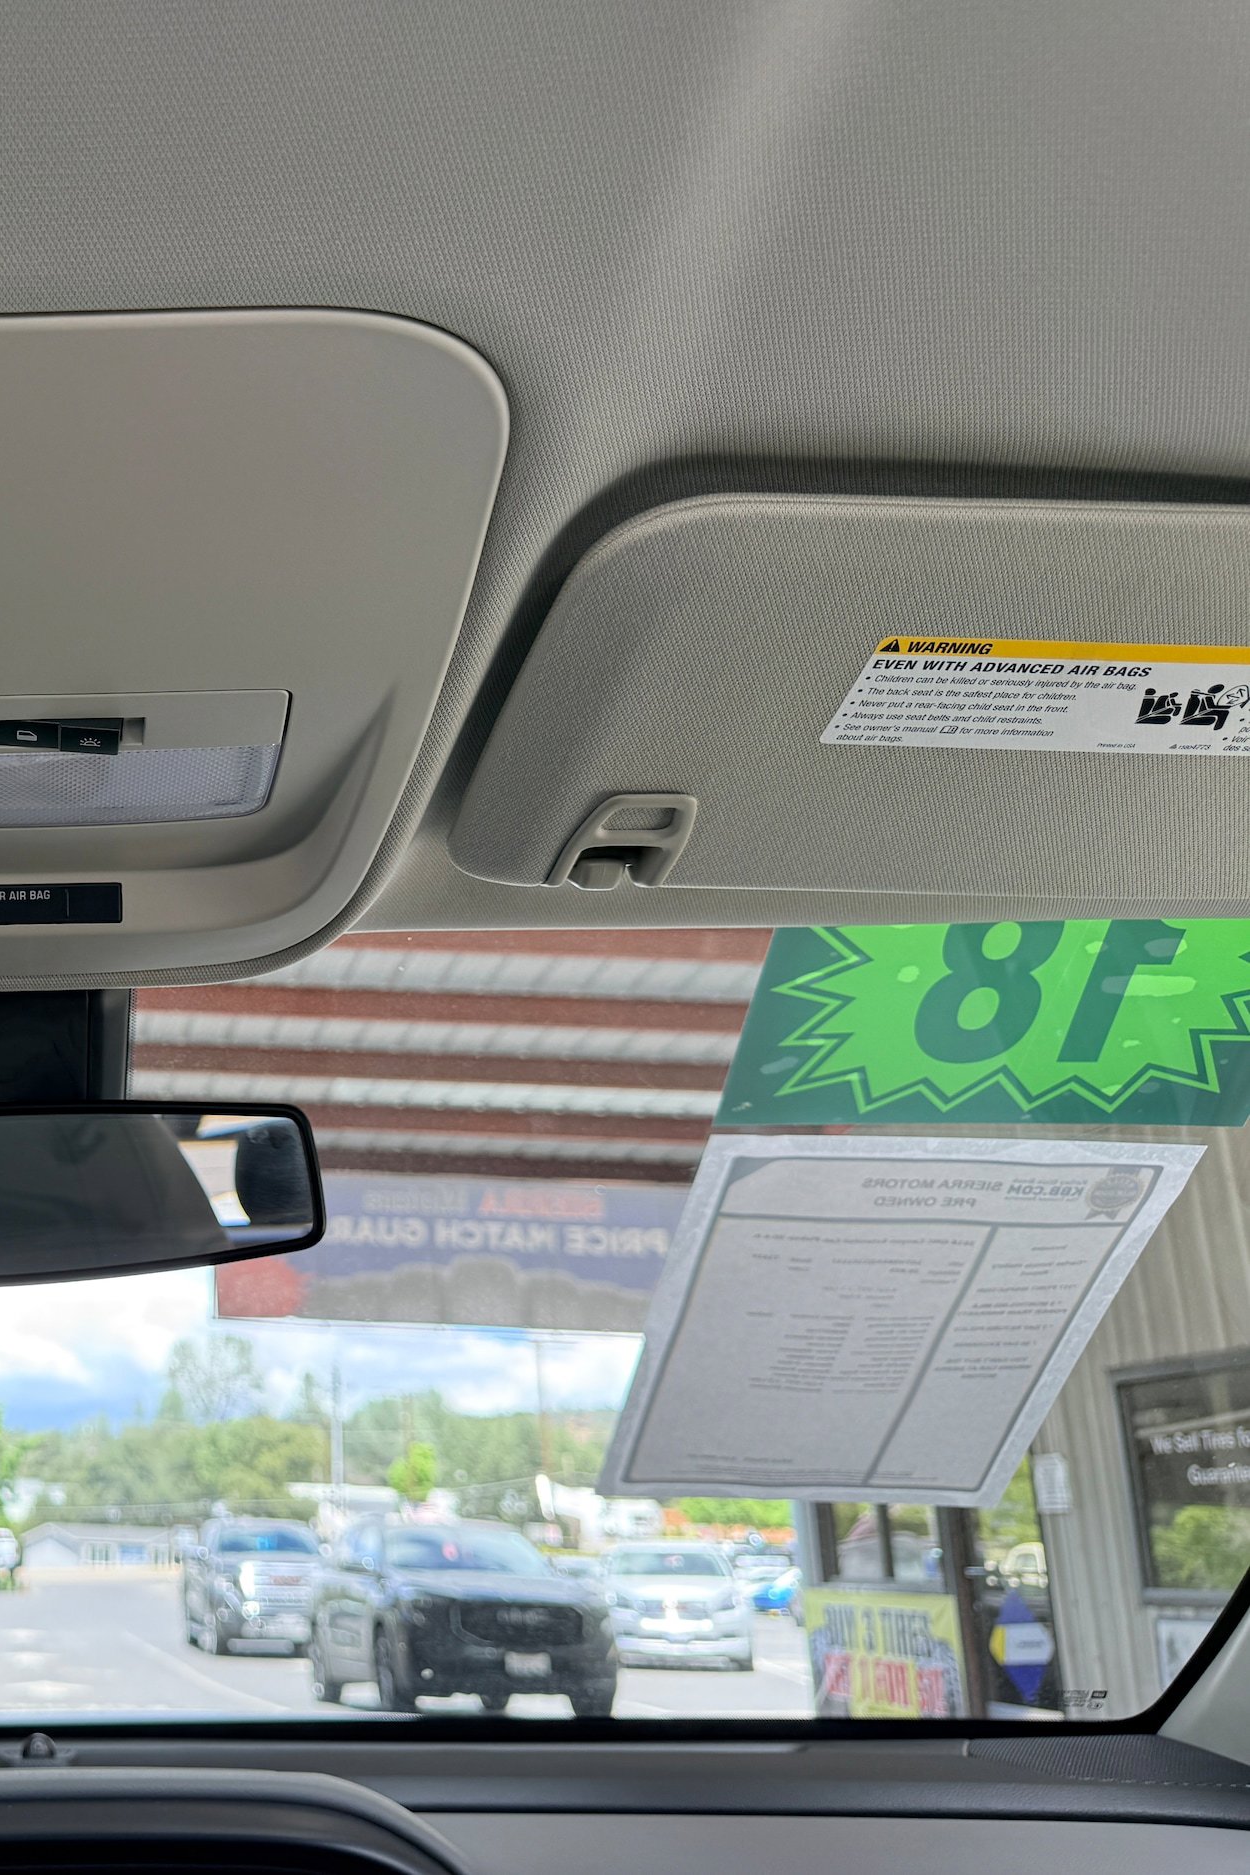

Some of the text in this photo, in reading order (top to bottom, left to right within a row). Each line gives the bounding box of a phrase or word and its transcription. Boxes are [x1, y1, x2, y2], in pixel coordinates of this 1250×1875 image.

[907, 642, 993, 654] WARNING
[873, 660, 1152, 677] EVEN WITH ADVANCED AIR BAGS
[875, 675, 914, 683] Children
[936, 676, 948, 684] be
[950, 677, 976, 685] killed
[991, 679, 1033, 688] seriously
[1035, 680, 1069, 689] injured
[1070, 680, 1082, 689] by
[1084, 681, 1100, 689] the
[1117, 683, 1137, 691] bag.
[962, 691, 992, 699] safest
[1037, 692, 1077, 701] children.
[888, 701, 905, 709] put
[914, 702, 965, 711] rear-facing
[850, 712, 884, 720] Always
[905, 713, 927, 721] seat
[863, 724, 900, 732] owner's
[902, 725, 937, 733] manual
[959, 727, 972, 735] for
[1000, 729, 1054, 737] information
[879, 735, 903, 743] bags.
[9, 891, 26, 900] AIR
[30, 890, 50, 900] BAG
